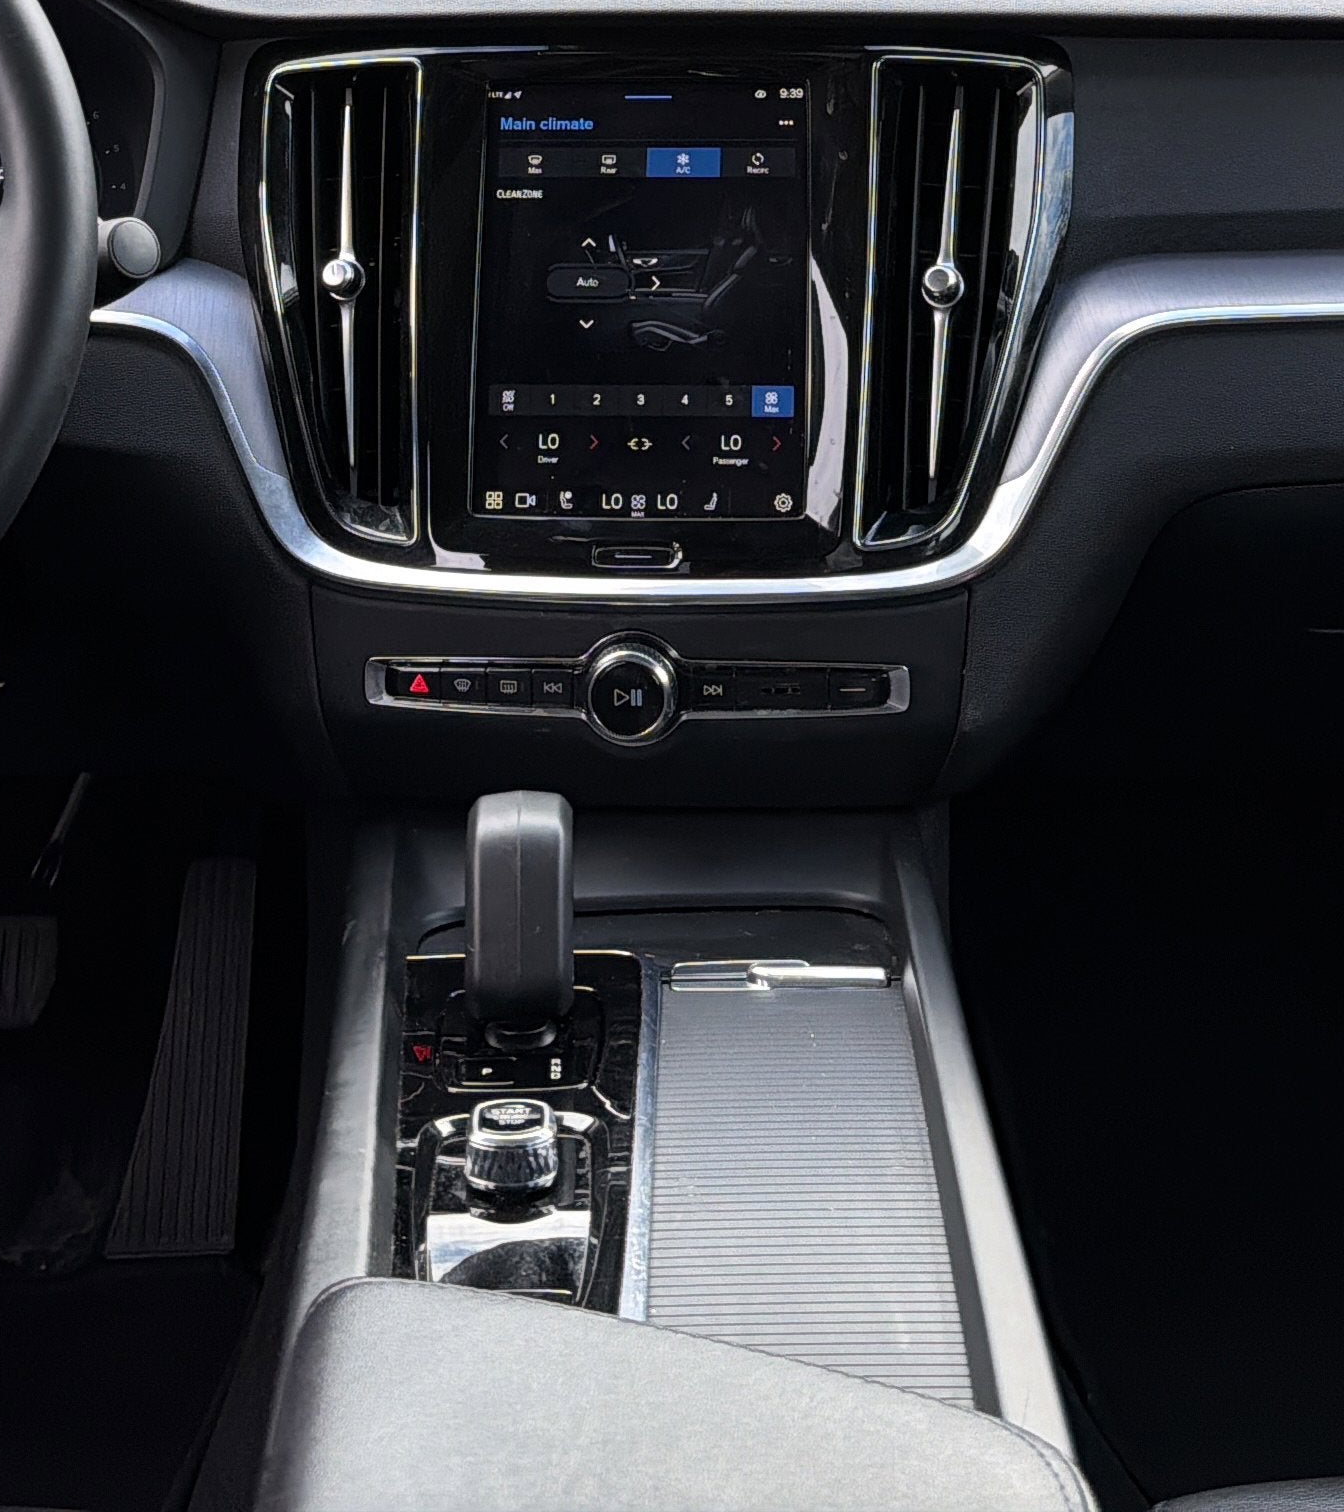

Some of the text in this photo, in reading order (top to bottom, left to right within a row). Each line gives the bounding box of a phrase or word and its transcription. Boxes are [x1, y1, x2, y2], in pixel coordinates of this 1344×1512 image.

[779, 88, 804, 99] 9:39
[500, 117, 594, 130] Main climate
[675, 166, 691, 174] A/C
[576, 276, 600, 287] Auto
[549, 393, 733, 406] 1 2 3 4 5
[502, 403, 514, 412] Off
[538, 433, 560, 449] LO
[720, 434, 742, 451] LO
[537, 455, 559, 464] Driver
[712, 456, 749, 467] Passenger
[601, 493, 623, 509] LO
[657, 493, 678, 510] LO
